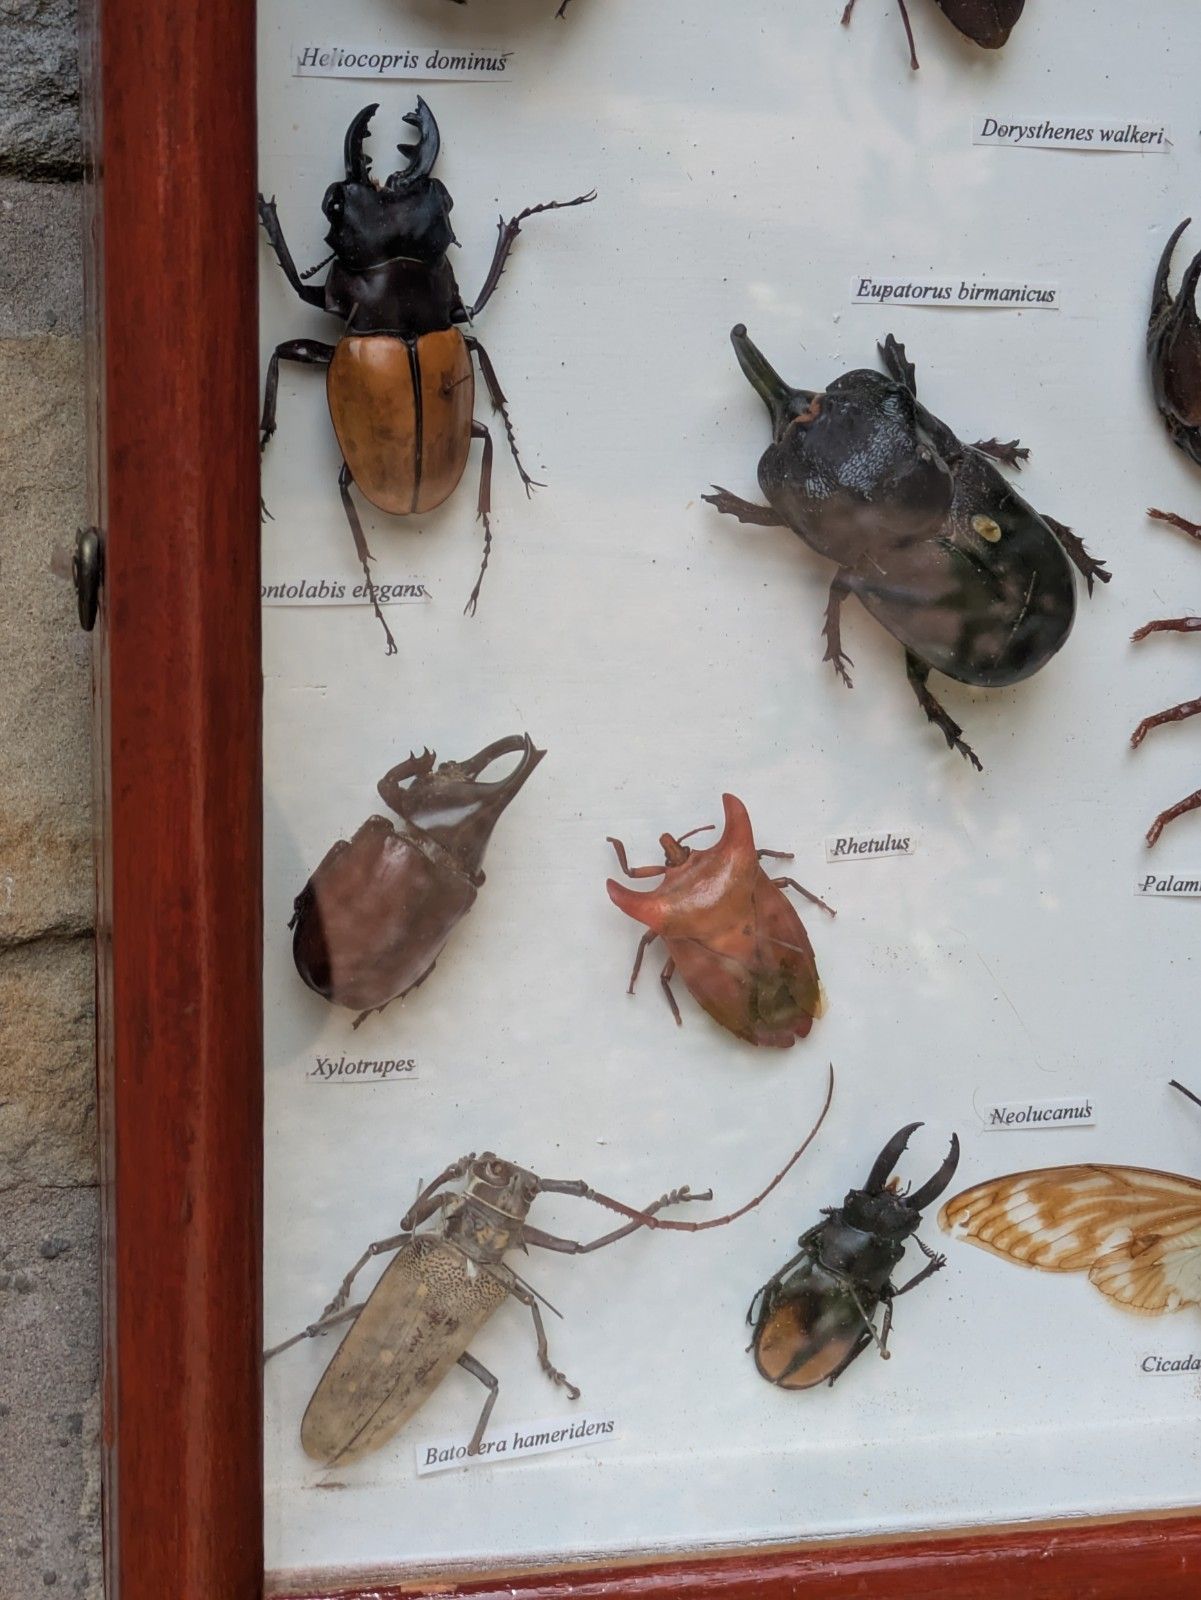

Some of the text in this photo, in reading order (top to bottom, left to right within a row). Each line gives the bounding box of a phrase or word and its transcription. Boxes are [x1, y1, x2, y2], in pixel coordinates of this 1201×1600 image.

[299, 48, 506, 74] Heliocopris dominus
[980, 119, 1164, 145] Dorysthenes walkeri
[856, 279, 1056, 303] Eupatorus birmanicus
[833, 834, 910, 856] Rhetulus
[1142, 875, 1201, 892] Palam
[310, 1057, 416, 1080] Xylotrupes
[991, 1105, 1092, 1126] Neolucanus
[1142, 1354, 1201, 1372] Cicada
[512, 1420, 615, 1451] hameridens
